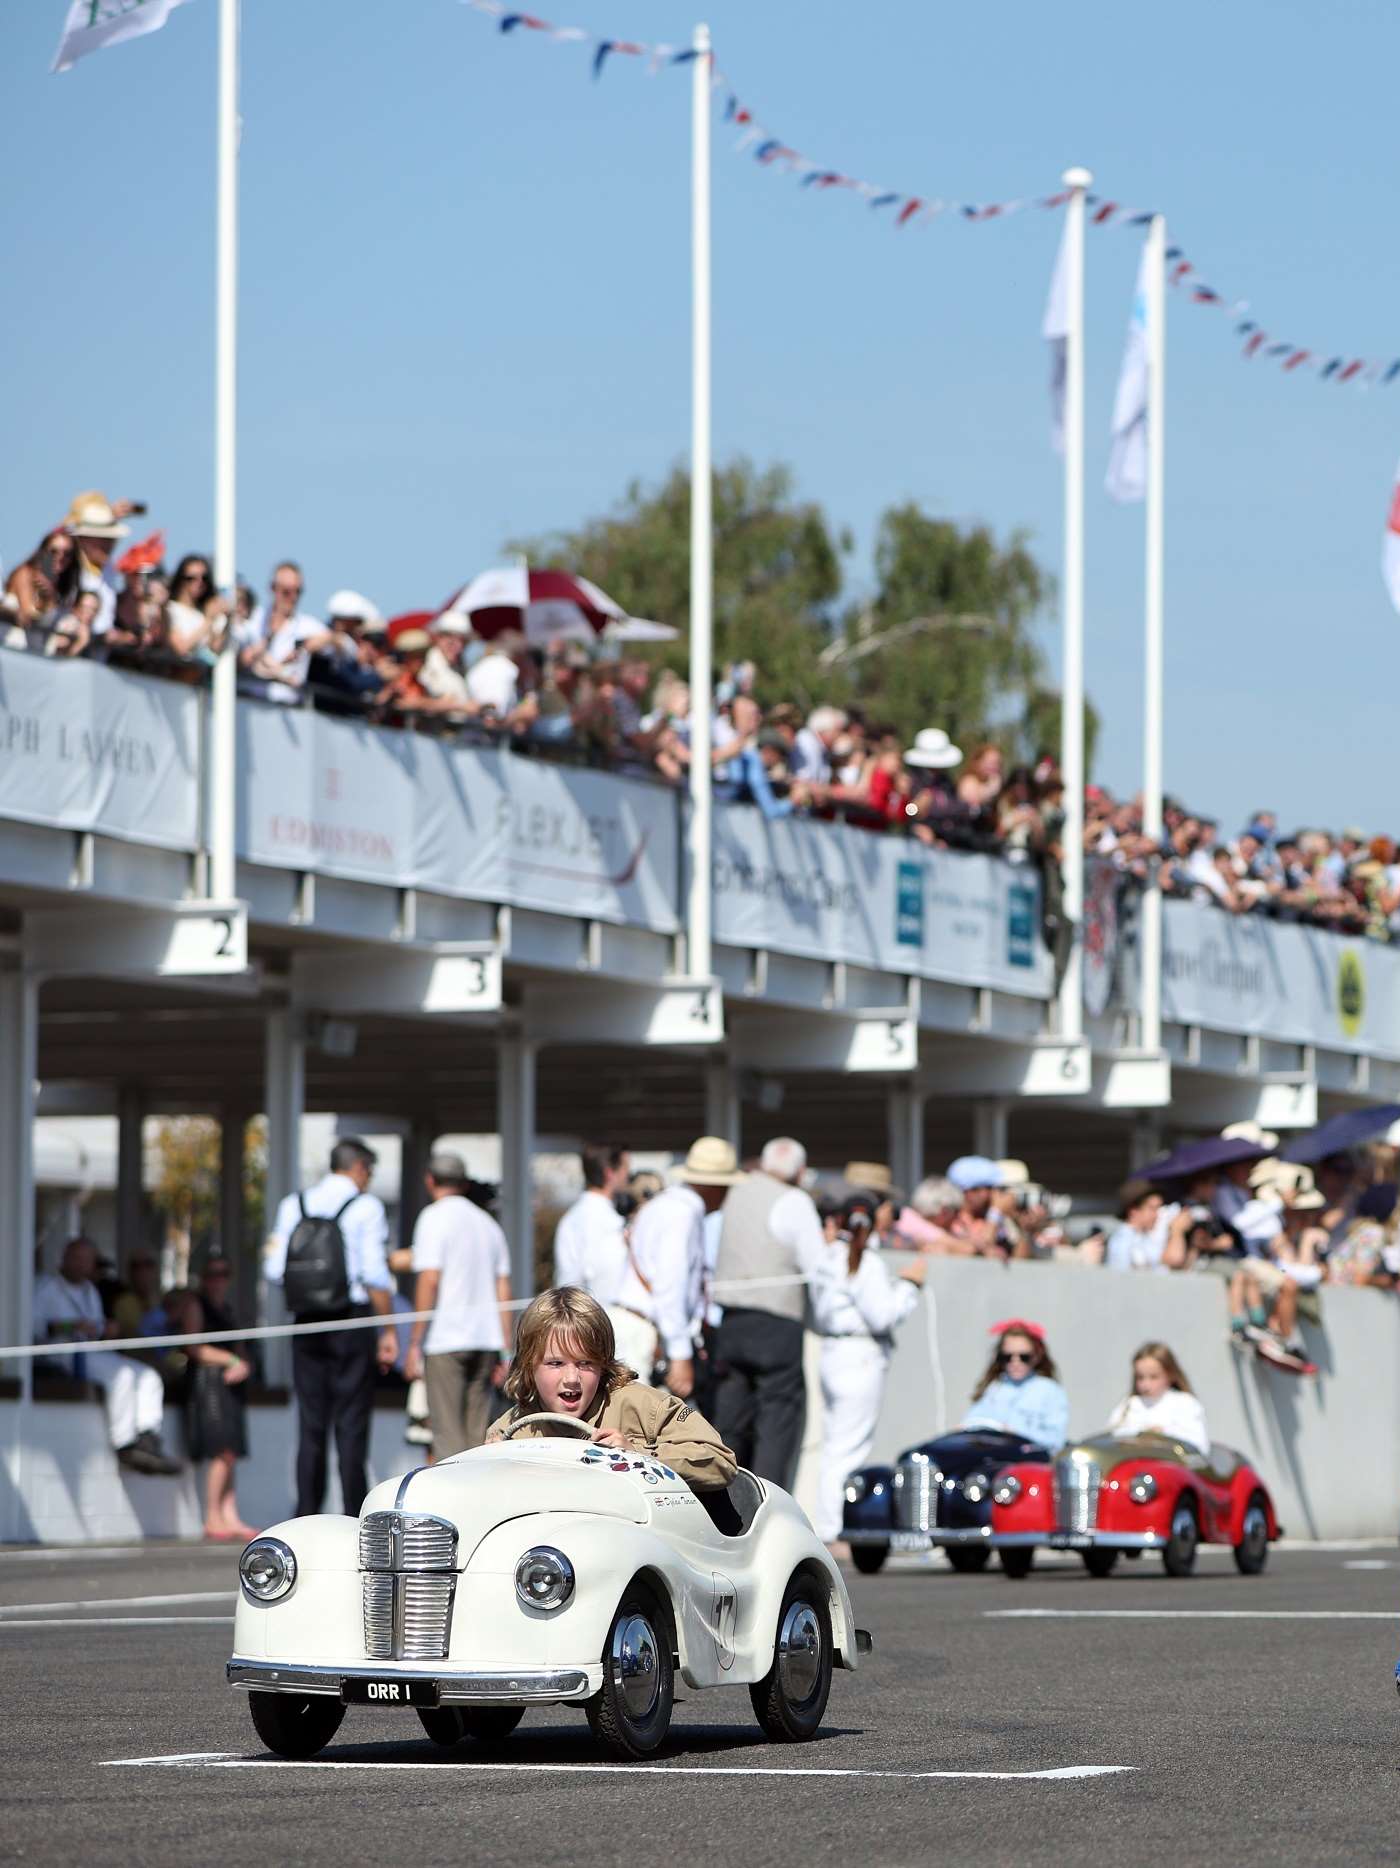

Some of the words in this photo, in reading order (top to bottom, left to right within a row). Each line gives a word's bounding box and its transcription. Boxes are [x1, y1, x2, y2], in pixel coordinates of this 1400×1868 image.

[213, 917, 234, 957] 2
[467, 957, 488, 995] 3
[690, 988, 711, 1026] 4
[884, 1020, 904, 1055] 5
[1059, 1047, 1080, 1079] 6
[1288, 1083, 1304, 1112] 7
[367, 1683, 400, 1700] ORR
